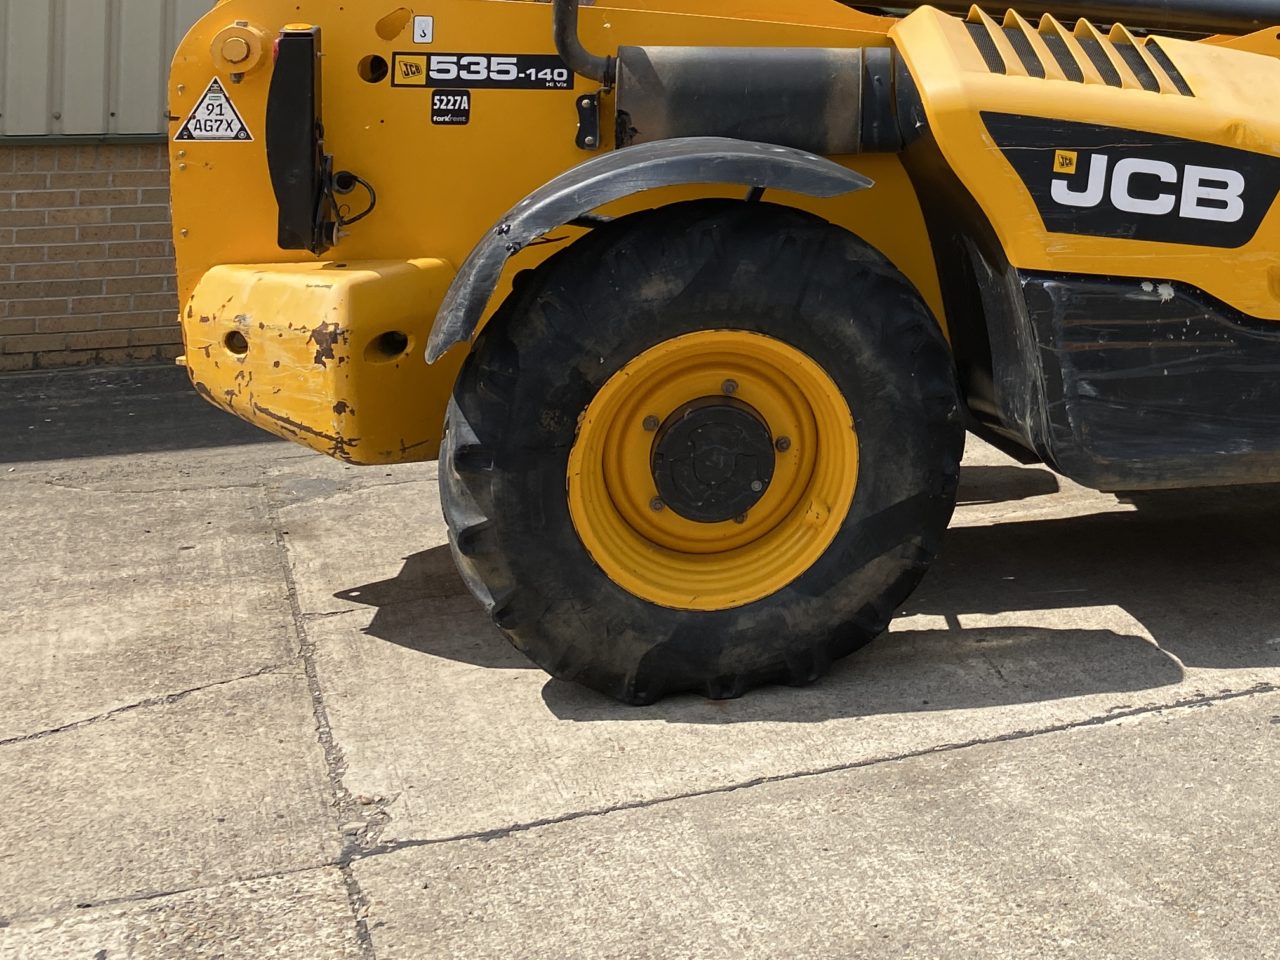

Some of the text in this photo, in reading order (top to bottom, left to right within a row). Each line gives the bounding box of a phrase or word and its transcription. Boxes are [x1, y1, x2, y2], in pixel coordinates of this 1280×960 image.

[402, 62, 422, 78] JCB
[206, 103, 225, 116] 91
[433, 95, 469, 110] 5227A
[193, 119, 234, 133] AG7X
[1051, 153, 1245, 223] JCB
